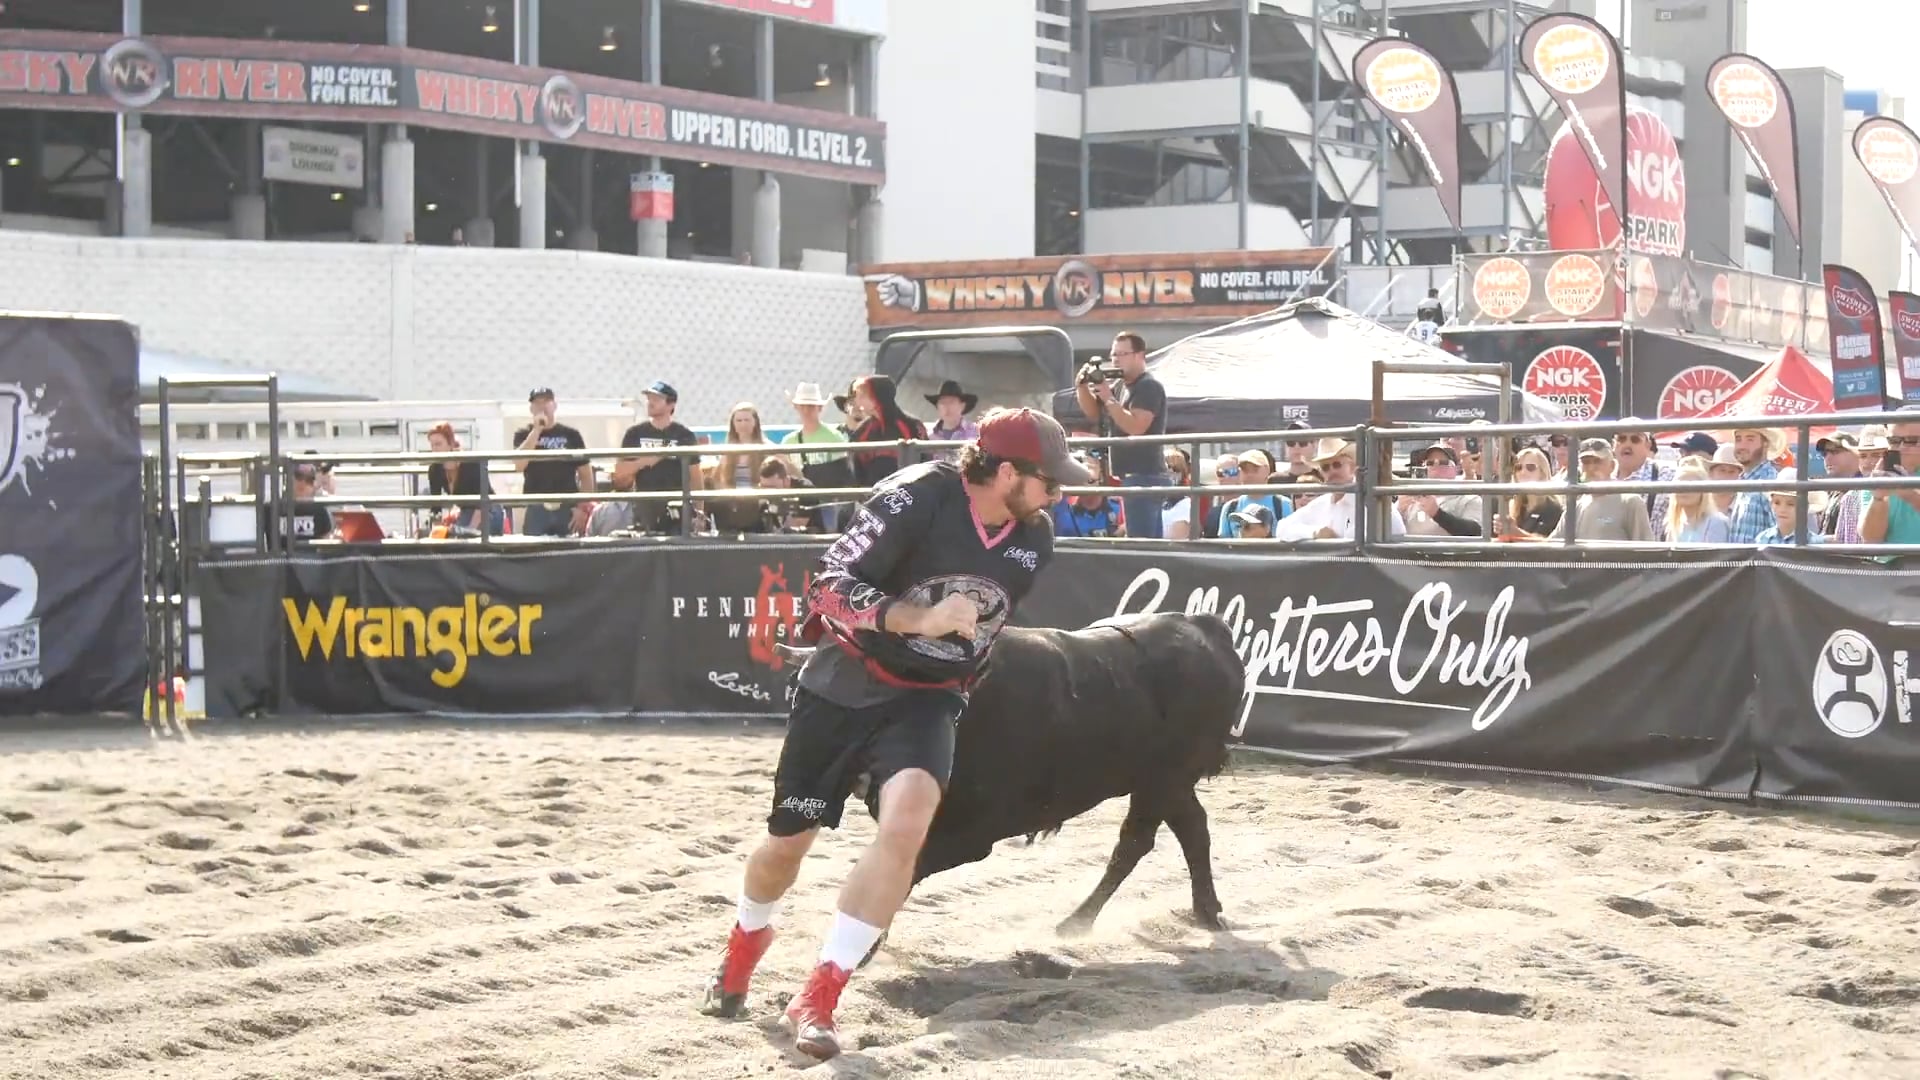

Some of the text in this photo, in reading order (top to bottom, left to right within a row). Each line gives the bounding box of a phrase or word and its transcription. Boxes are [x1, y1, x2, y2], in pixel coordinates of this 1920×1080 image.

[174, 56, 306, 101] RIVER
[311, 66, 335, 85] NO
[311, 84, 397, 106] FOR REAL.
[415, 69, 540, 124] WHISKY
[585, 94, 667, 142] RIVER
[671, 109, 737, 148] UPPER
[738, 119, 794, 157] FORD.
[797, 128, 852, 165] LEVEL
[855, 136, 872, 167] 2.
[1626, 149, 1680, 204] NGK
[1626, 217, 1678, 246] SPARK
[1483, 270, 1520, 286] NGK
[1554, 268, 1593, 283] NGK
[925, 275, 1052, 311] WHISKY
[1102, 271, 1195, 305] RIVER
[1200, 272, 1219, 288] NO
[1221, 271, 1264, 288] COVER.
[1265, 270, 1290, 286] FOR
[1537, 367, 1590, 388] NGK
[1541, 395, 1588, 405] PARK
[1762, 395, 1807, 411] SHER
[672, 596, 803, 618] PENDLE
[281, 593, 542, 688] Wrangler
[728, 623, 803, 639] WHISK
[1388, 581, 1531, 731] Only
